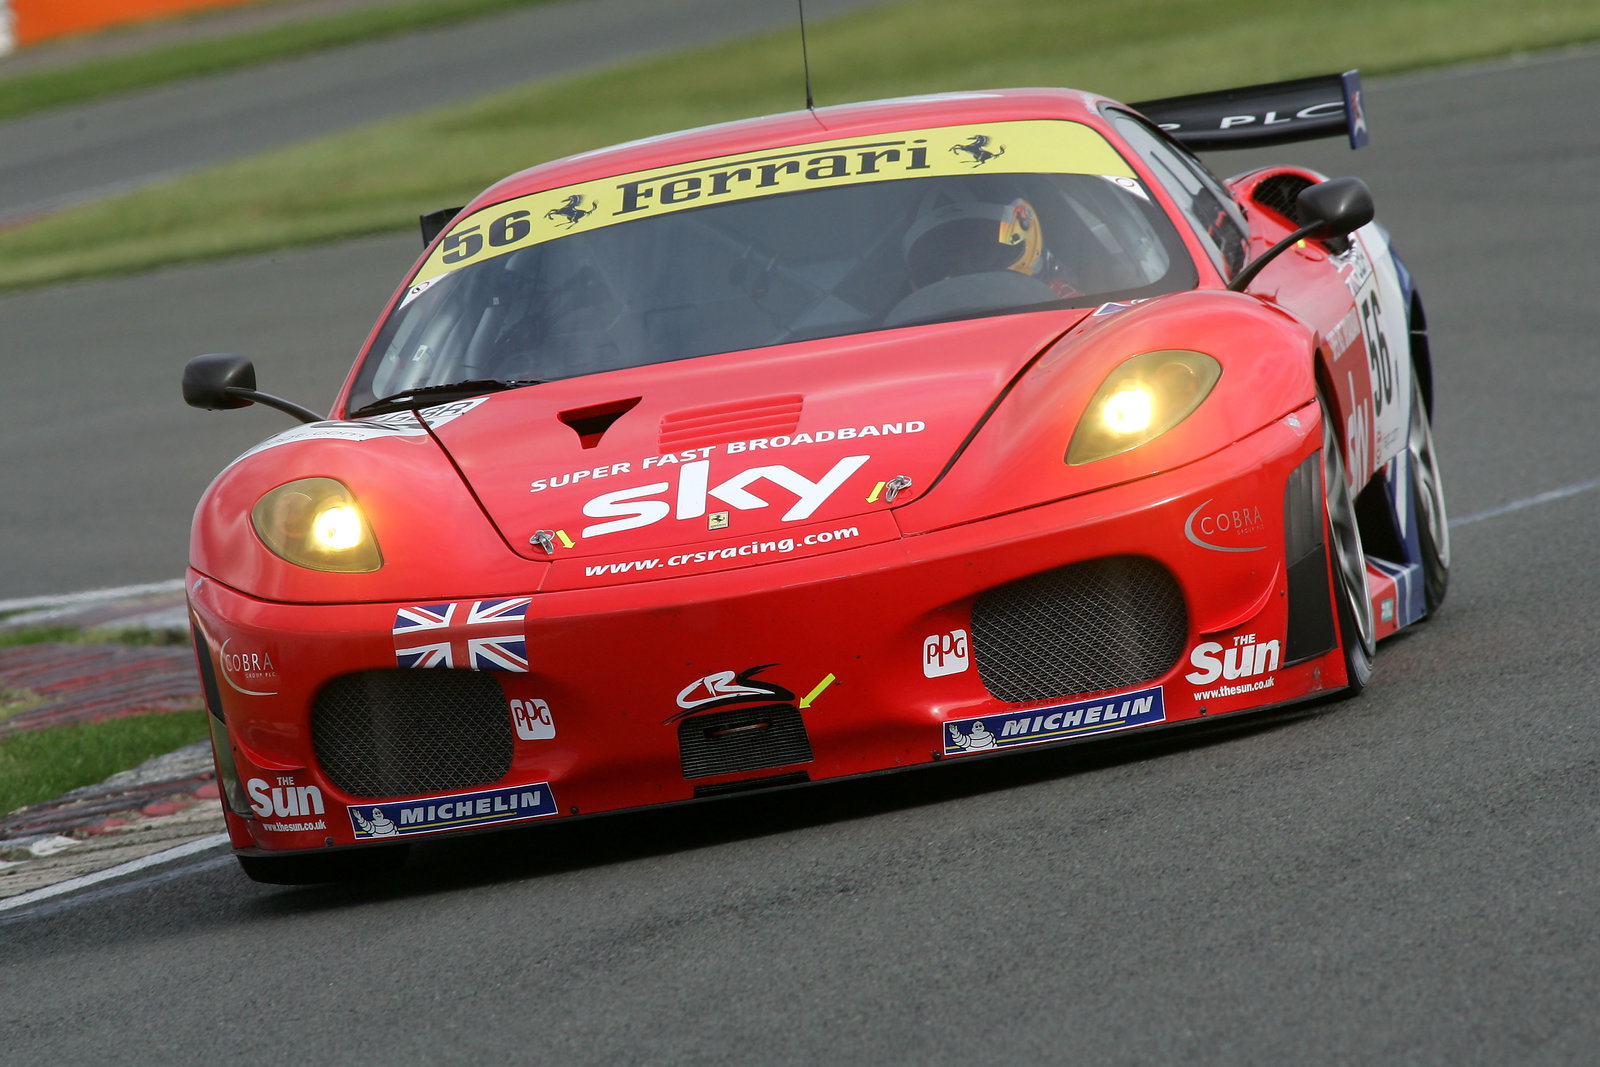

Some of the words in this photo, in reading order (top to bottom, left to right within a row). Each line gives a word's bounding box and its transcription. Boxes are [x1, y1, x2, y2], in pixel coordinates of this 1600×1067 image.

[442, 210, 531, 264] 56
[612, 139, 931, 216] Ferrari
[1361, 289, 1392, 417] 56
[529, 461, 631, 493] SUPER
[641, 445, 716, 470] FAST
[726, 420, 926, 455] BROADBAND
[581, 454, 871, 539] sky
[1200, 505, 1263, 535] COBRA
[584, 523, 860, 577] www.crsracing.com
[926, 631, 966, 668] PPG
[1233, 633, 1256, 646] THE
[225, 652, 274, 672] COBRA
[1185, 639, 1280, 685] Sun
[1193, 676, 1275, 701] www.thesun.co.uk
[513, 699, 551, 732] PPG
[1000, 694, 1154, 737] MICHELIN
[247, 778, 325, 818] Sun
[276, 776, 295, 786] THE
[400, 790, 541, 824] MICHELIN
